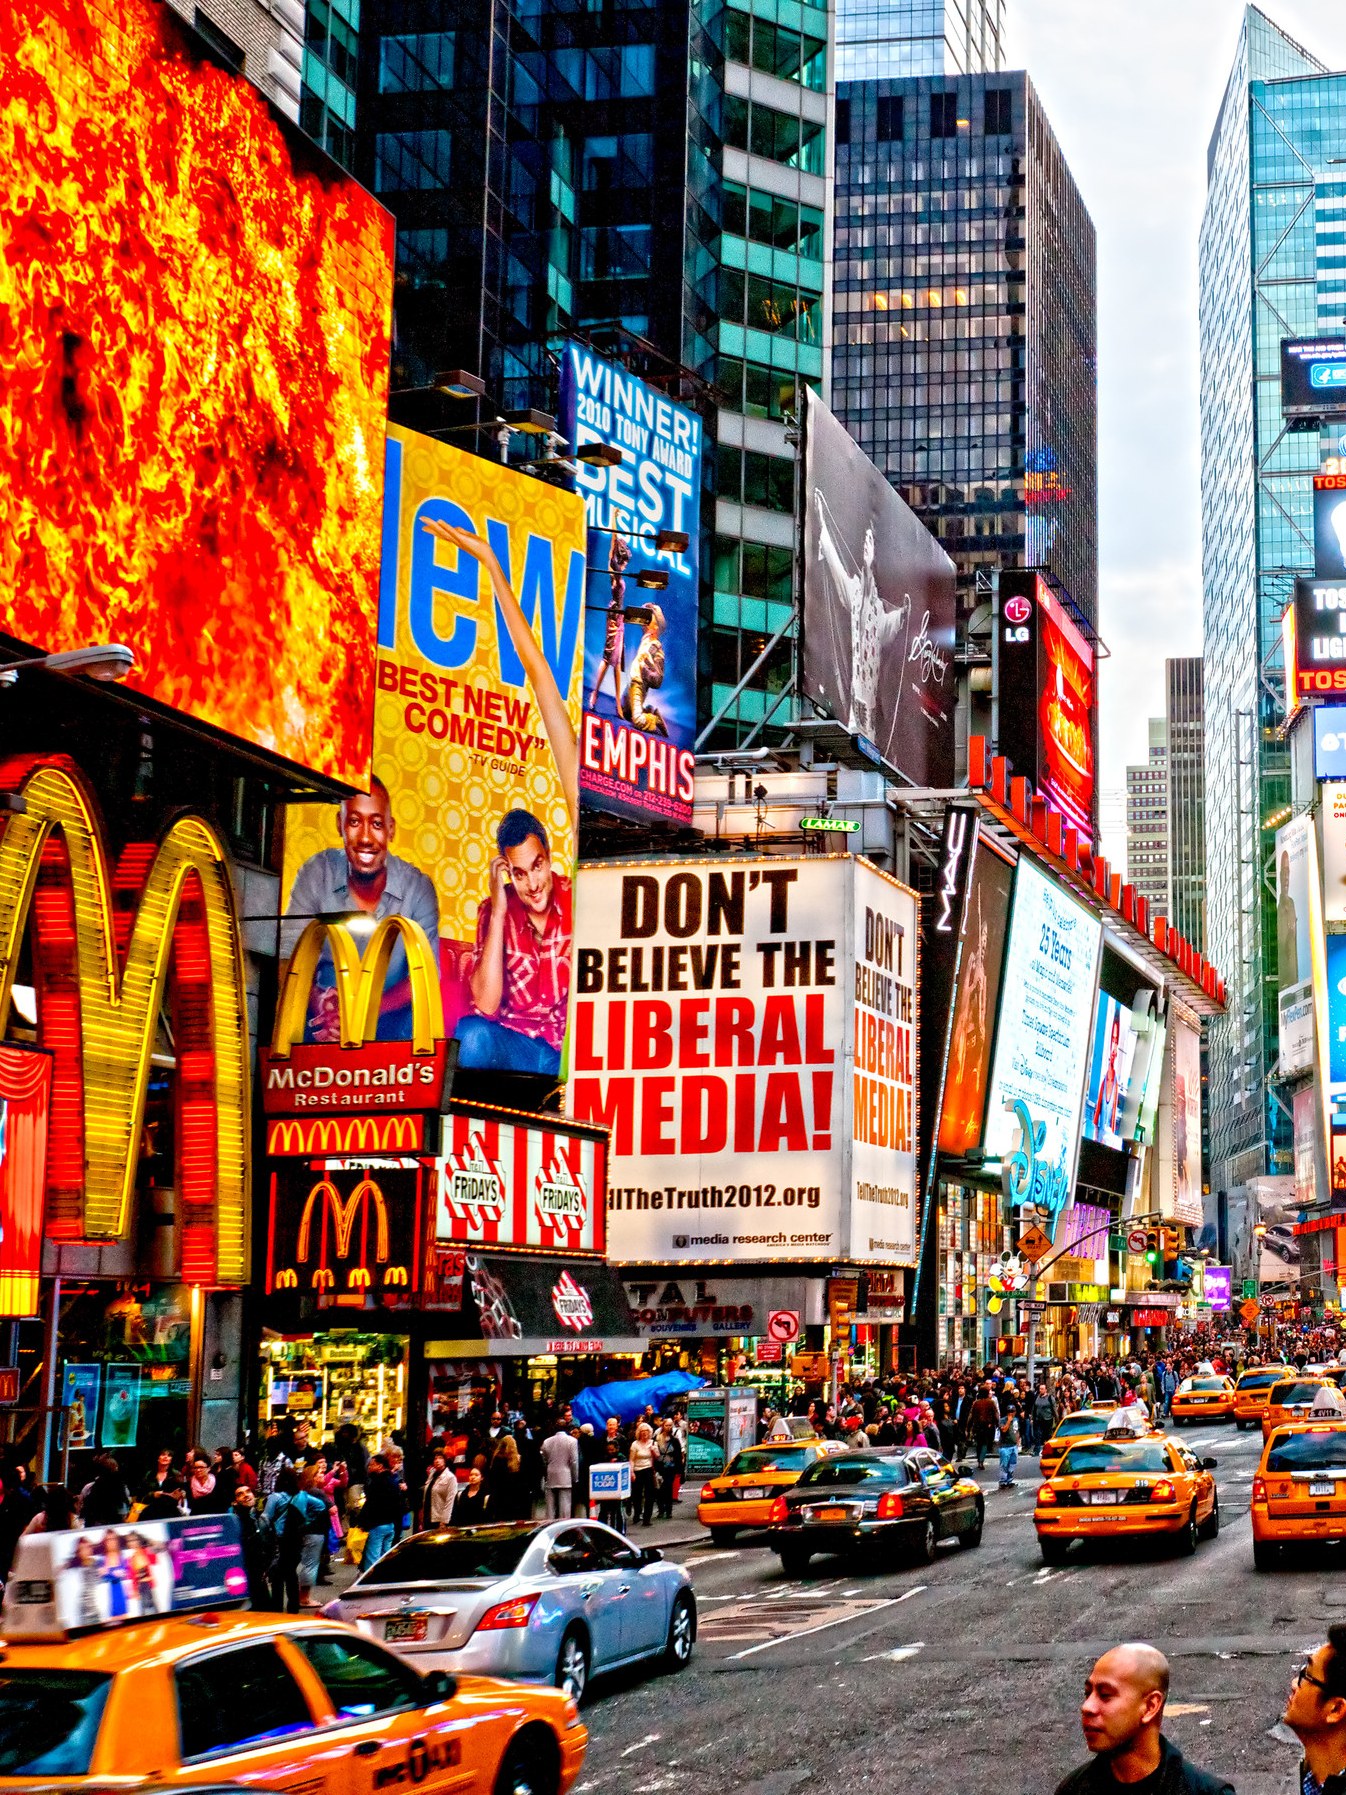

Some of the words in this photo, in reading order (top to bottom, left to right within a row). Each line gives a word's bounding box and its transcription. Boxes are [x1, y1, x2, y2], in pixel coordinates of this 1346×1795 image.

[571, 347, 699, 455] WINNER!
[577, 392, 610, 433] 2010
[615, 412, 648, 454] TONY
[652, 436, 692, 480] AWARD
[575, 421, 692, 534] BEST
[1005, 627, 1029, 642] LG
[377, 659, 459, 709] BEST
[463, 684, 531, 730] NEW
[490, 757, 527, 778] GUIDE
[804, 818, 857, 831] LAMAR
[620, 868, 799, 940] DON'T
[576, 943, 742, 995] BELIEVE
[756, 939, 837, 989] THE
[864, 905, 906, 979] DON'T
[1039, 922, 1050, 955] 25
[1050, 930, 1073, 971] Years
[854, 961, 893, 1015] BELIEVE
[894, 983, 913, 1024] THE
[574, 993, 835, 1072] LIBERAL
[853, 1007, 913, 1087] LIBERAL
[267, 1063, 435, 1090] McDonald's
[294, 1089, 406, 1107] Restaurant
[572, 1070, 834, 1156] MEDIA!
[853, 1074, 913, 1154] MEDIA!
[856, 1180, 910, 1210] TellTheTruth2012.org
[690, 1233, 729, 1246] media
[732, 1232, 787, 1245] research
[789, 1232, 831, 1243] center
[628, 1281, 718, 1306] TAL
[712, 1321, 752, 1331] GALLERY
[1135, 1479, 1149, 1488] 919
